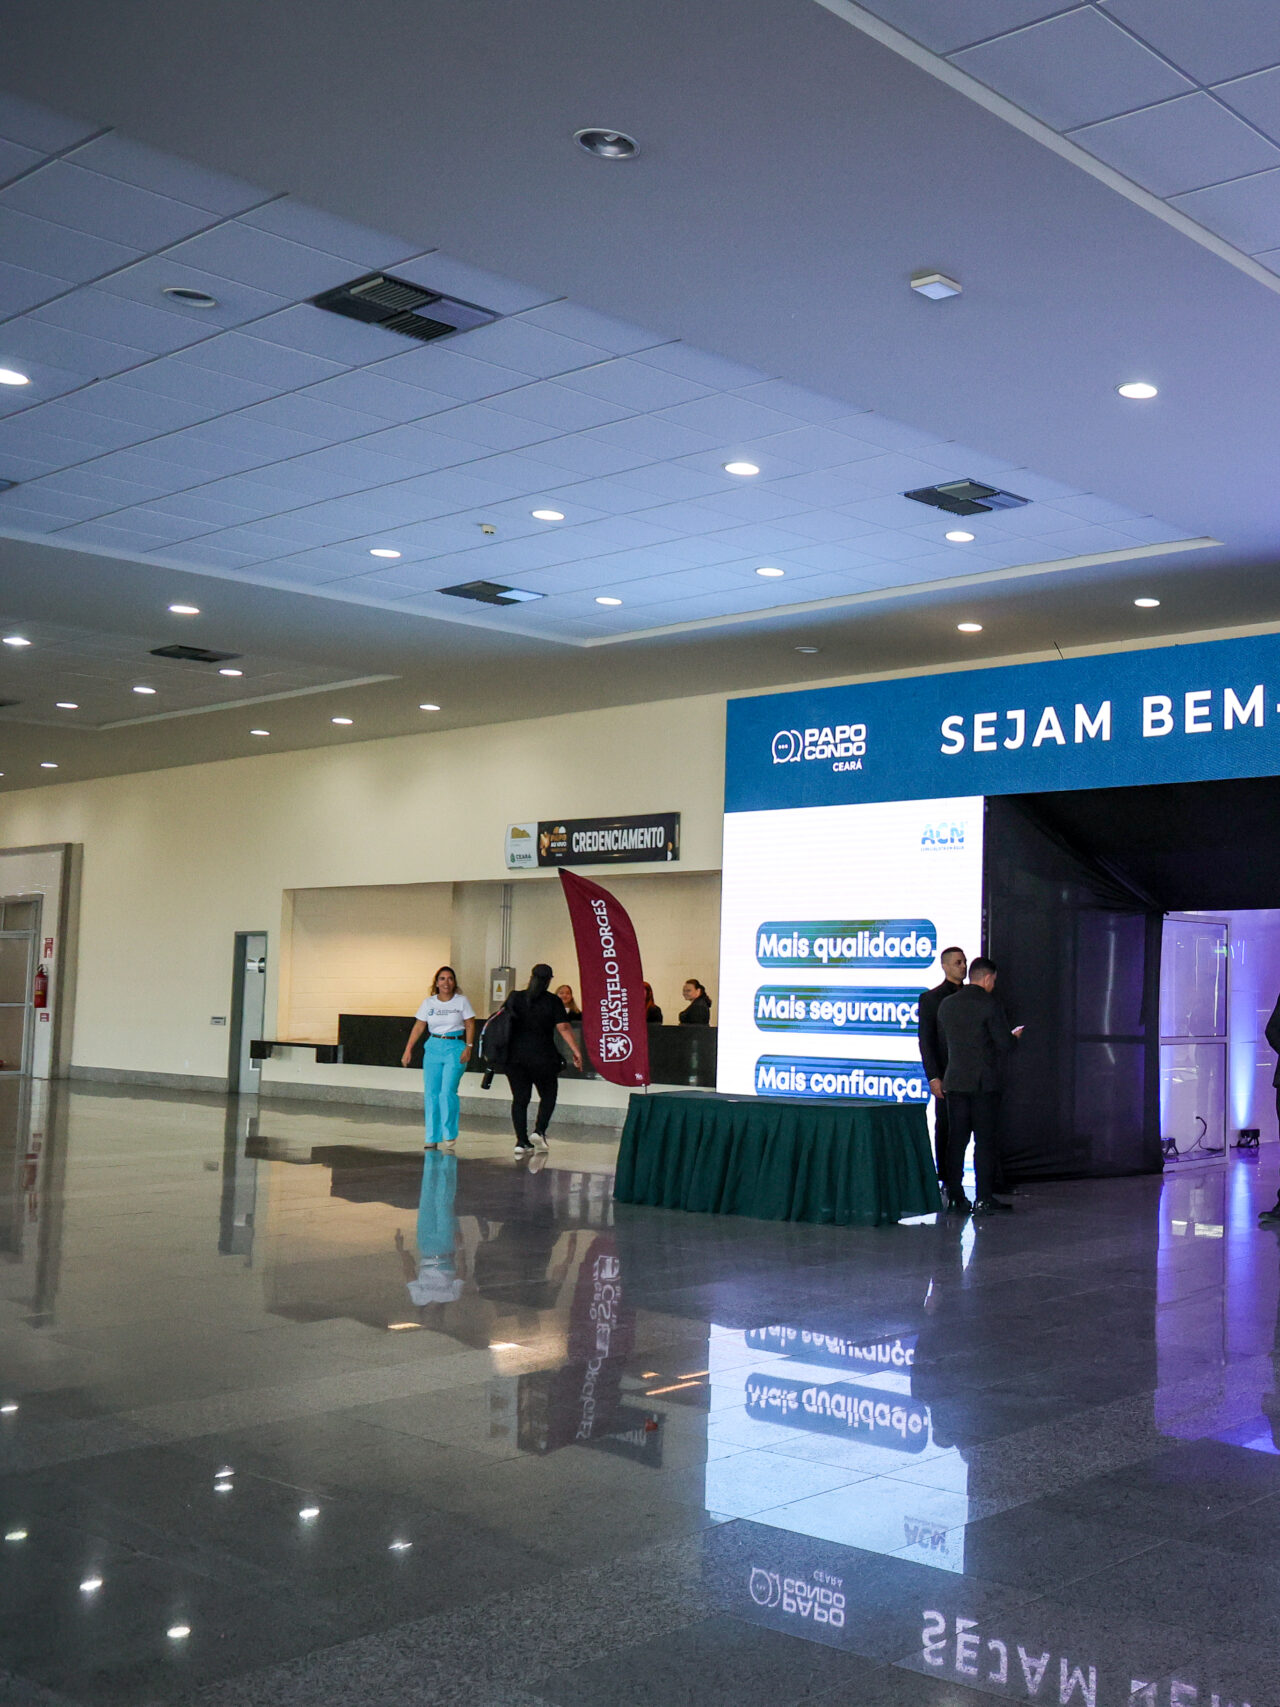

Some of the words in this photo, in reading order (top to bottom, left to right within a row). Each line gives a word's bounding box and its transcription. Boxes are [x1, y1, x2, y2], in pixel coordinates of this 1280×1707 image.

[804, 723, 867, 746] PAPO
[940, 700, 1112, 755] SEJAM
[804, 741, 866, 760] CONDO
[832, 758, 863, 772] CEARÁ
[572, 826, 665, 853] CREDENCIAMENTO
[921, 821, 965, 845] ACN
[591, 898, 617, 958] BORGES
[758, 932, 810, 959] Mais
[813, 931, 936, 964] qualidade.
[604, 960, 622, 1032] CASTELO
[757, 994, 806, 1020] Mais
[600, 998, 609, 1032] GRUPO
[757, 1066, 807, 1092] Mais
[810, 1070, 928, 1104] confiança.
